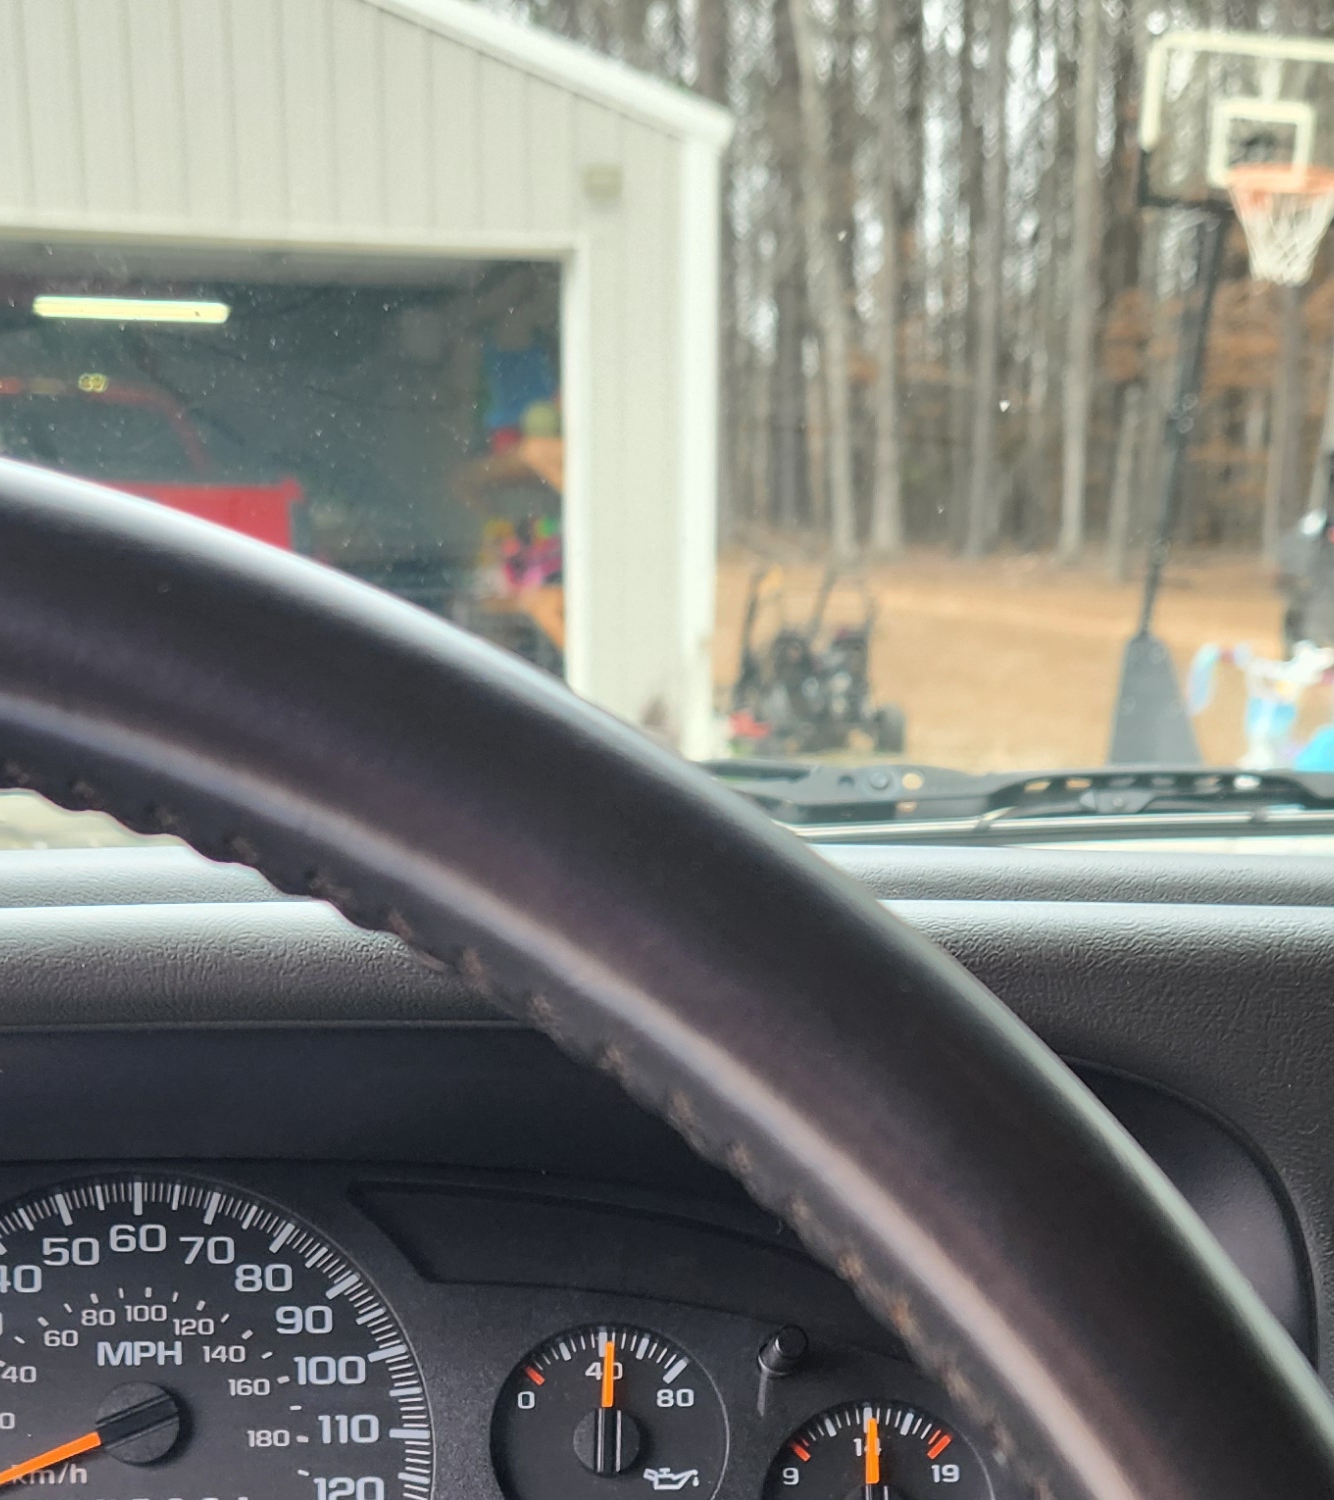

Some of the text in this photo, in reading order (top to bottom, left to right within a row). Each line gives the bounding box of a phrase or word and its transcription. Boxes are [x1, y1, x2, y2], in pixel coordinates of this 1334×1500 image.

[110, 1224, 166, 1252] 60
[43, 1238, 99, 1265] 50
[179, 1237, 234, 1264] 70
[235, 1264, 292, 1292] 80
[81, 1309, 115, 1326] 80
[125, 1305, 167, 1322] 100
[276, 1306, 332, 1334] 90
[173, 1319, 214, 1335] 120
[44, 1330, 78, 1346] 60
[98, 1341, 182, 1366] MPH
[203, 1346, 245, 1362] 140
[1, 1366, 36, 1383] 40
[294, 1356, 365, 1385] 100
[585, 1362, 623, 1380] 40
[228, 1379, 270, 1396] 160
[518, 1391, 535, 1409] 0
[657, 1389, 694, 1407] 80
[318, 1415, 379, 1443] 110
[247, 1430, 289, 1447] 180
[783, 1468, 799, 1485] 9
[932, 1464, 959, 1482] 19
